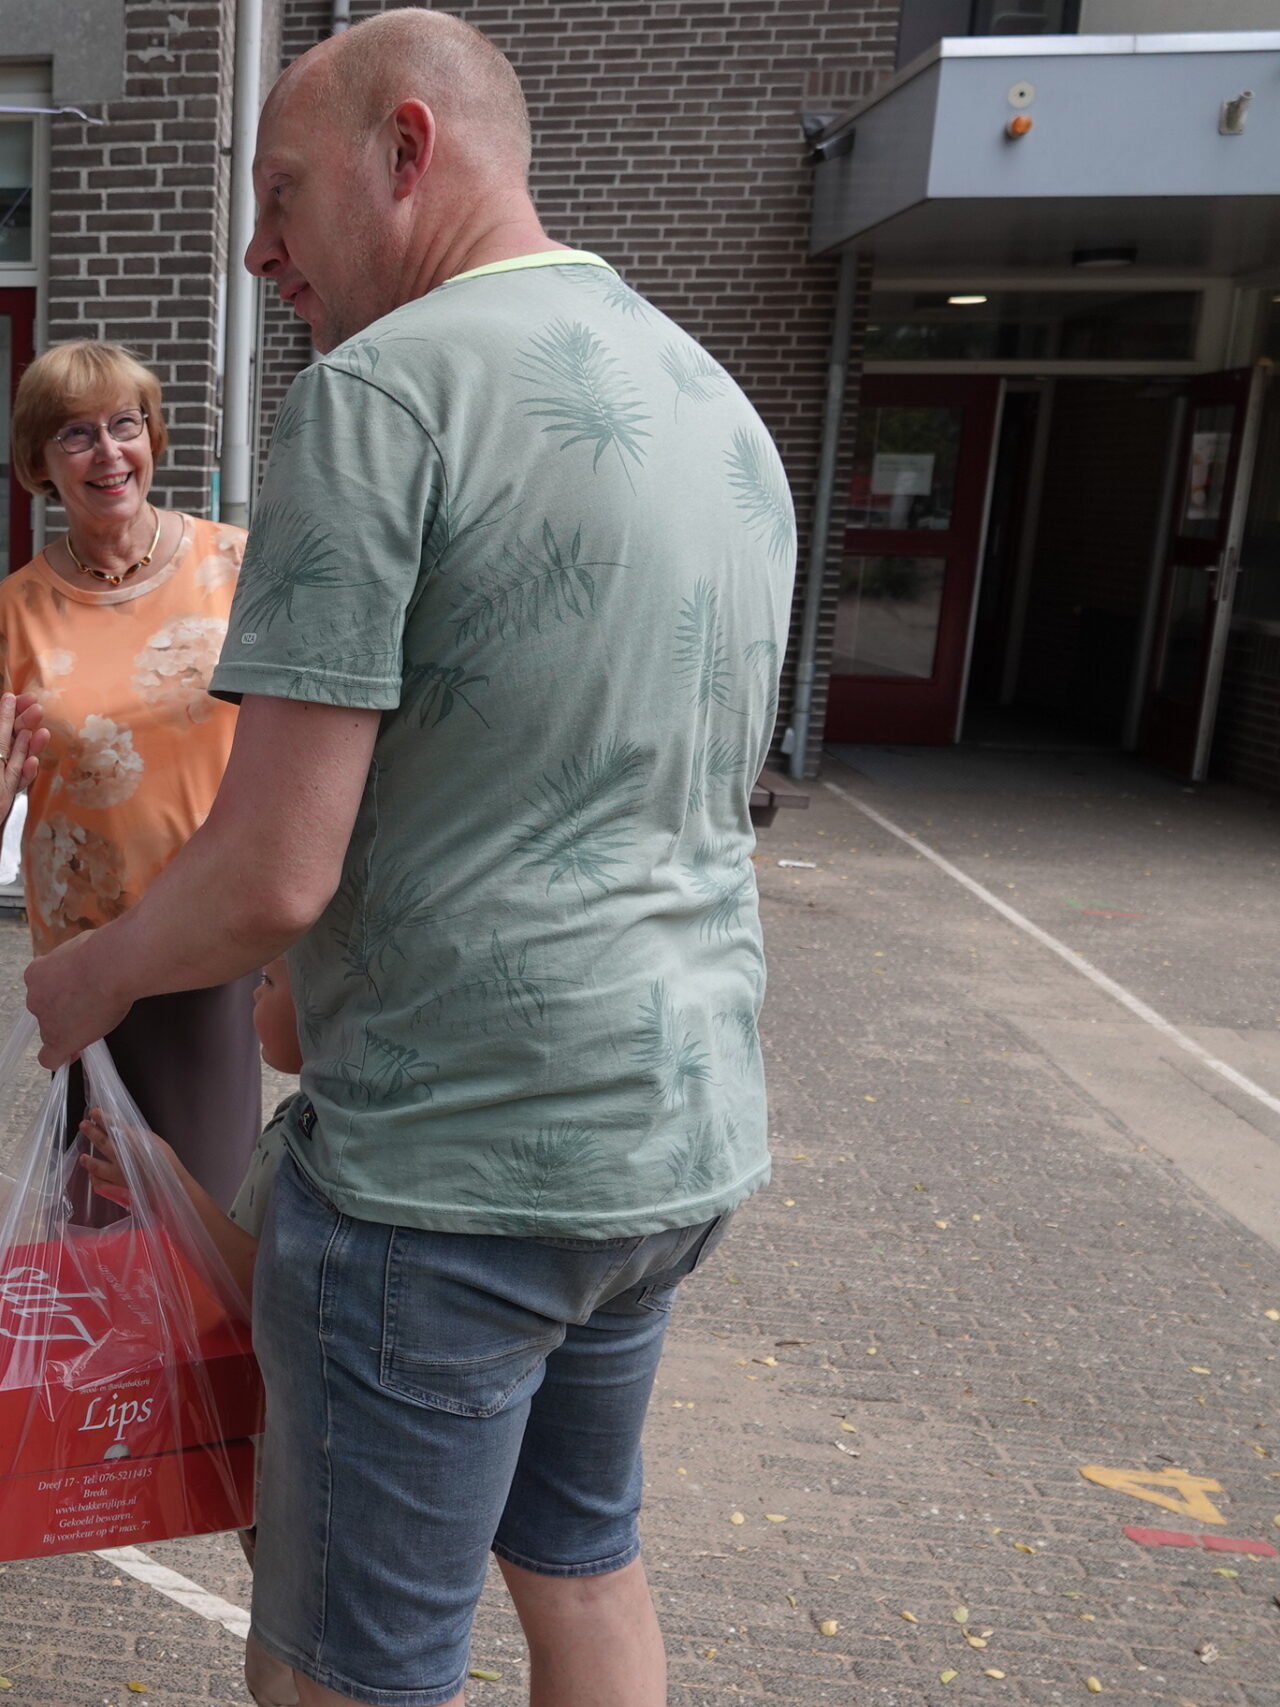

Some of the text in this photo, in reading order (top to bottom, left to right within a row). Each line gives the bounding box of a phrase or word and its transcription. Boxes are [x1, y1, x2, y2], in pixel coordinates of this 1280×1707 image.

[78, 1393, 154, 1440] Lips
[38, 1480, 61, 1491] Dreef
[64, 1477, 75, 1487] 17
[99, 1468, 152, 1483] 076-5211415
[83, 1488, 108, 1498] Breda
[55, 1497, 136, 1515] www.bakkerijlips.nl
[59, 1513, 134, 1528] Gekoeld bewaren.
[43, 1533, 56, 1544] Bij
[57, 1529, 95, 1541] voorkeur
[96, 1529, 107, 1537] op
